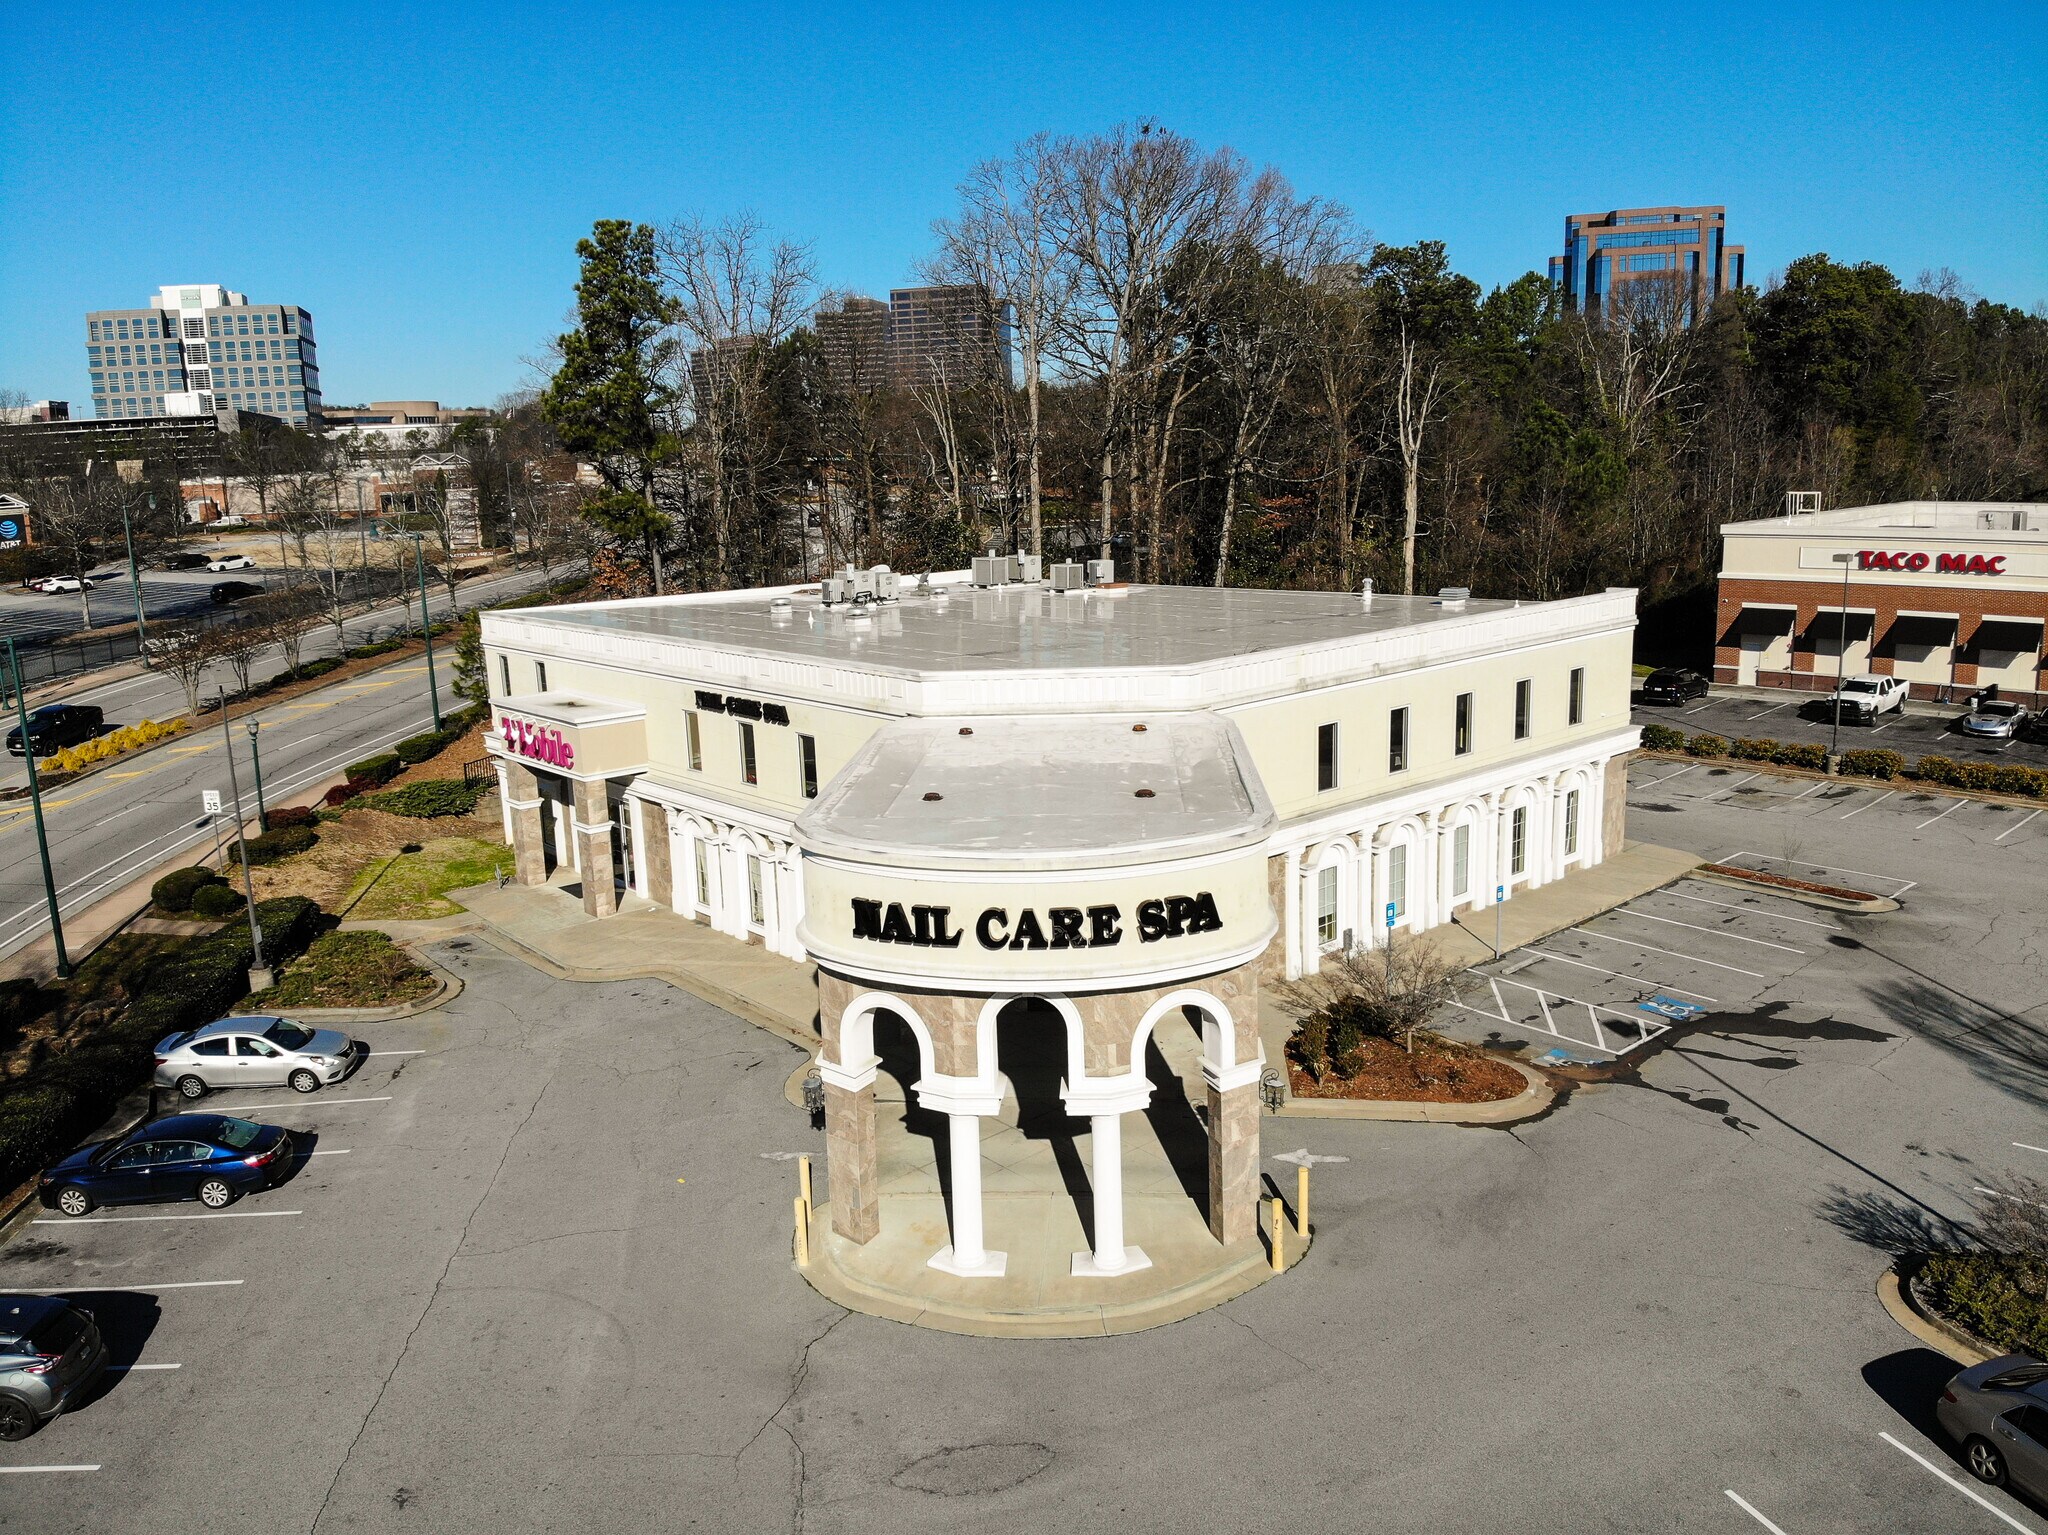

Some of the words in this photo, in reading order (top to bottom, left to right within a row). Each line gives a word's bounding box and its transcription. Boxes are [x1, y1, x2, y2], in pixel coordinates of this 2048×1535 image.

[1854, 550, 1930, 572] TACO
[1936, 553, 2007, 576] MAC
[501, 716, 575, 770] TMobile
[206, 802, 219, 811] 35
[851, 896, 965, 949] NAIL
[976, 903, 1123, 951] CARE
[1136, 892, 1224, 944] SPA
